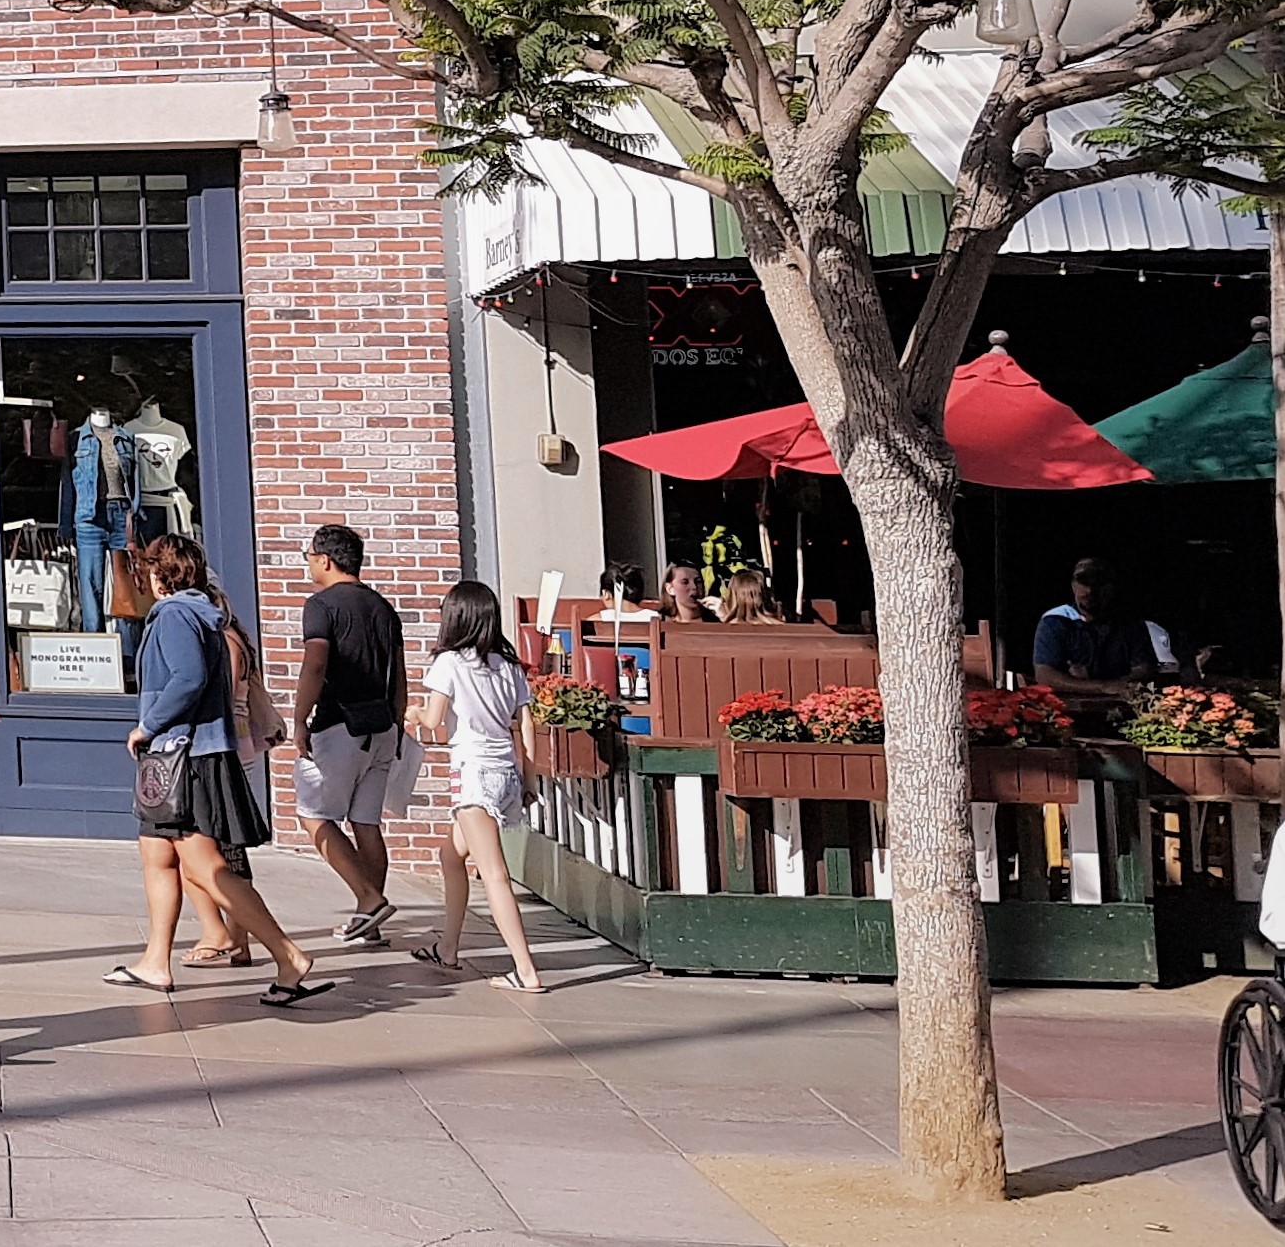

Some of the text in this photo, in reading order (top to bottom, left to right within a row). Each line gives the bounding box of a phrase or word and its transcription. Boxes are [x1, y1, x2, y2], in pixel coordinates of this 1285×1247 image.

[484, 229, 520, 270] Barney's
[651, 347, 699, 366] DOS
[30, 655, 112, 663] MONOGRAMMING
